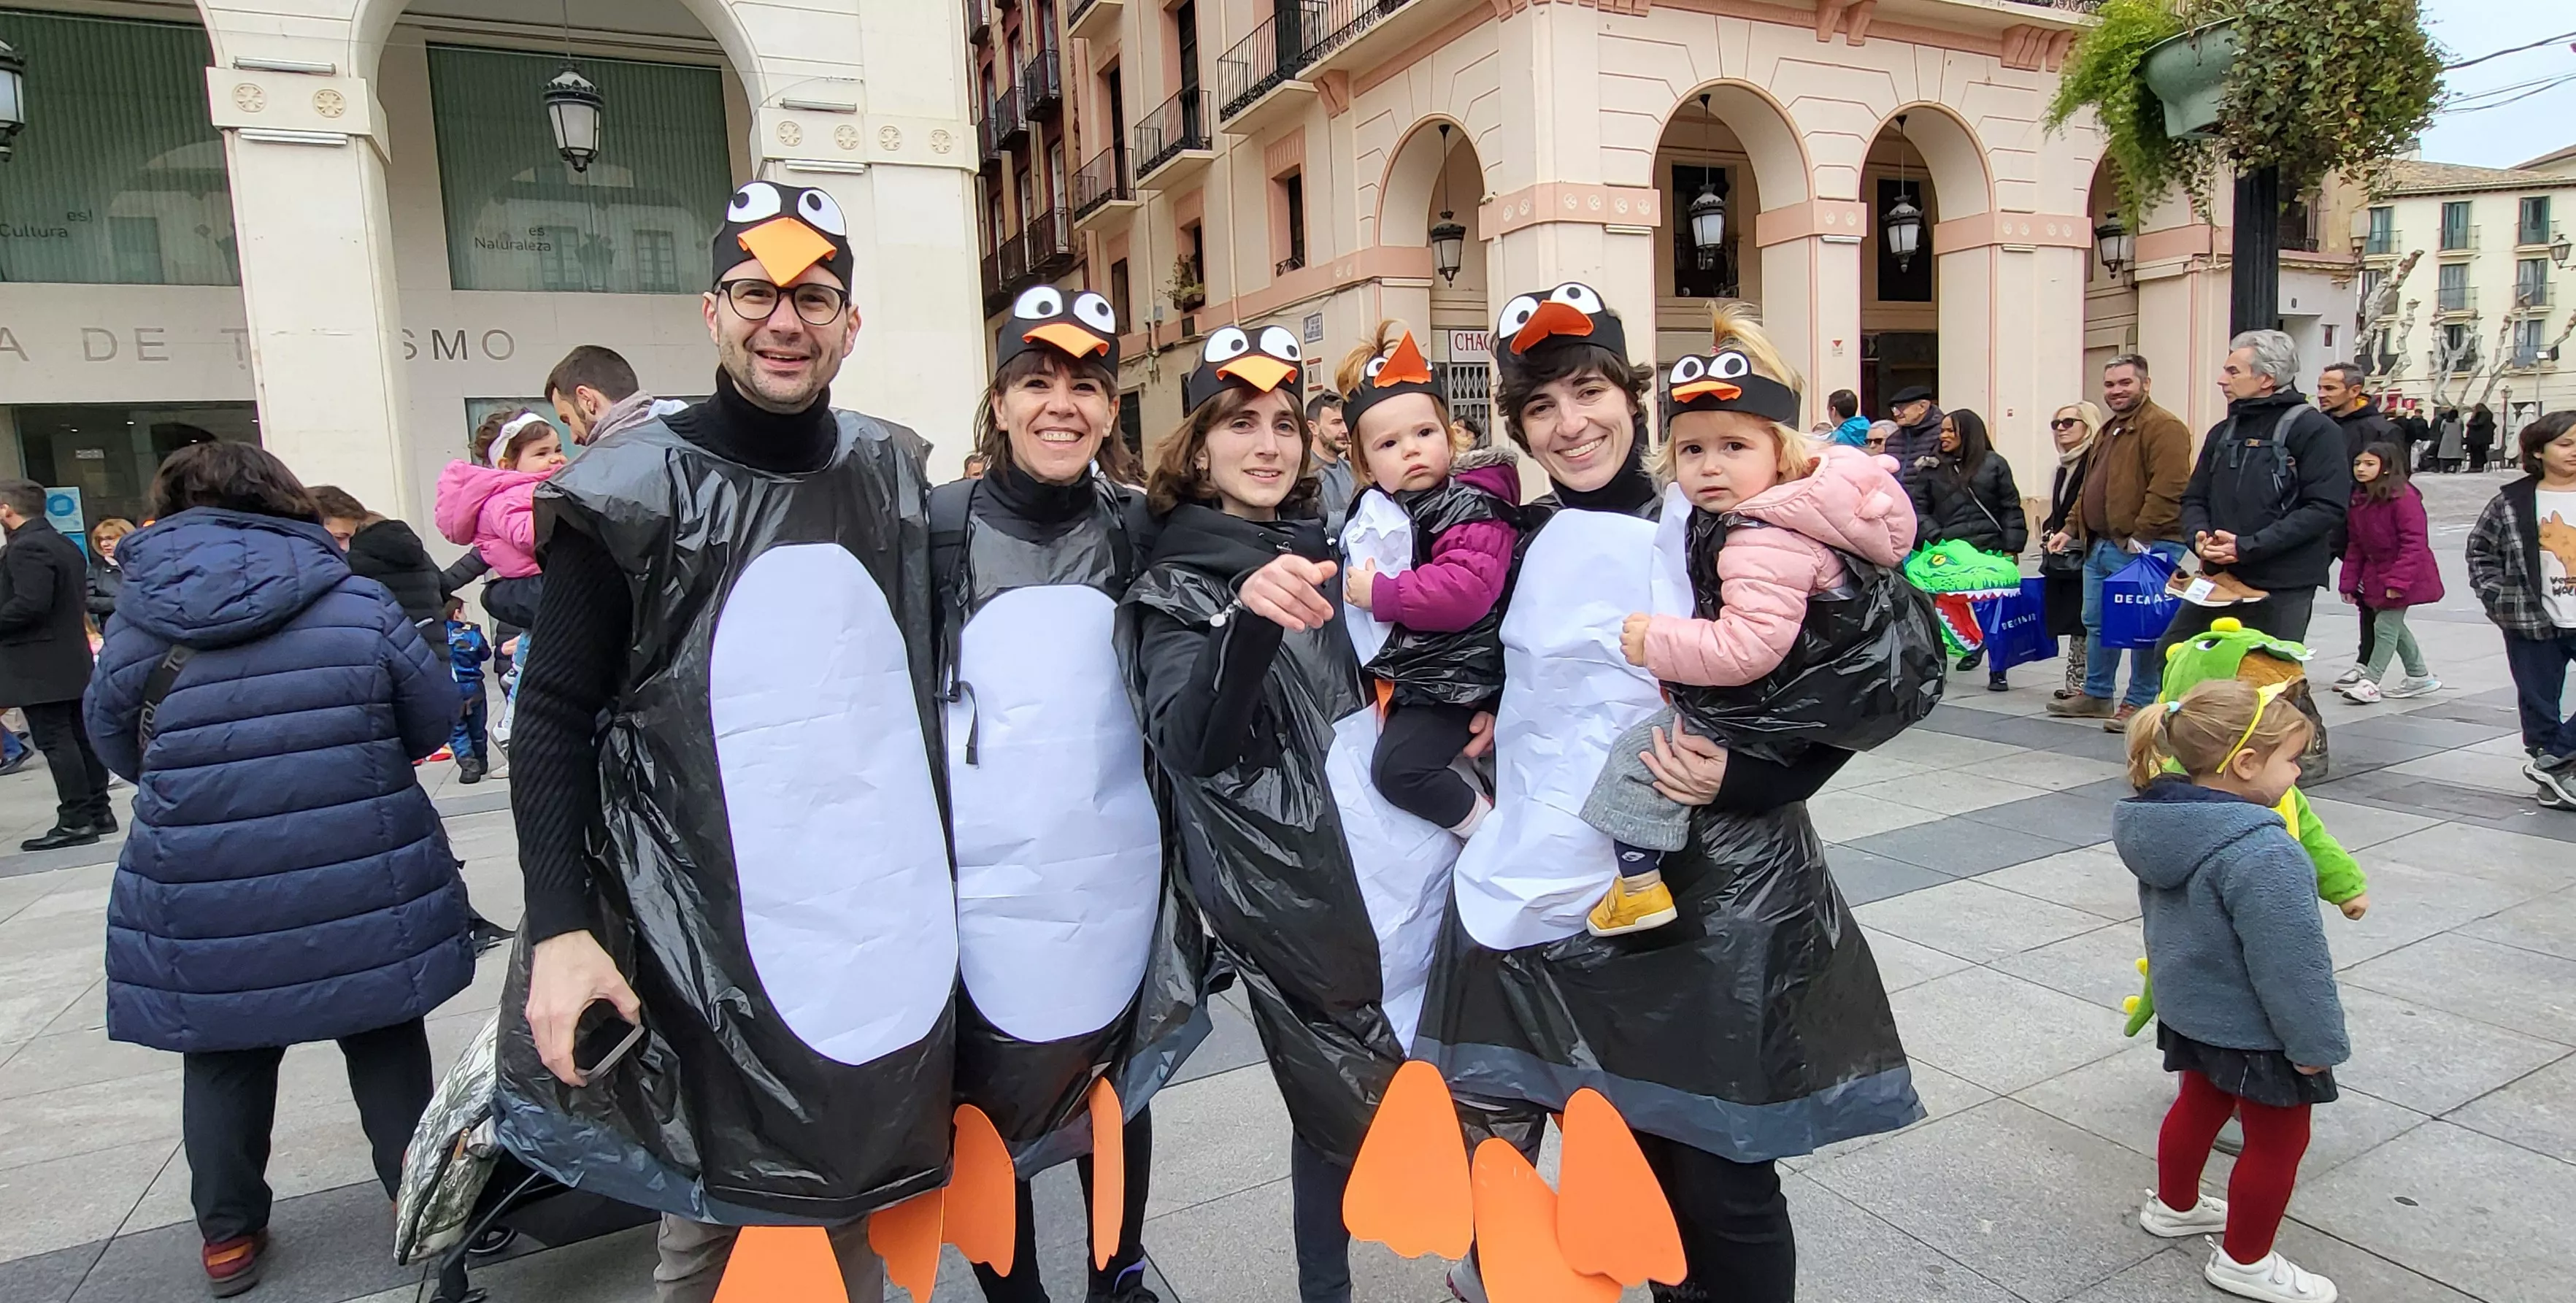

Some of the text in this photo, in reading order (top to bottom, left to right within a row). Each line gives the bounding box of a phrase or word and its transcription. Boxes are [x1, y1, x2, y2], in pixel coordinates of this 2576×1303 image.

[528, 227, 545, 237] es
[474, 237, 551, 251] Naturaleza
[80, 328, 169, 361] DE
